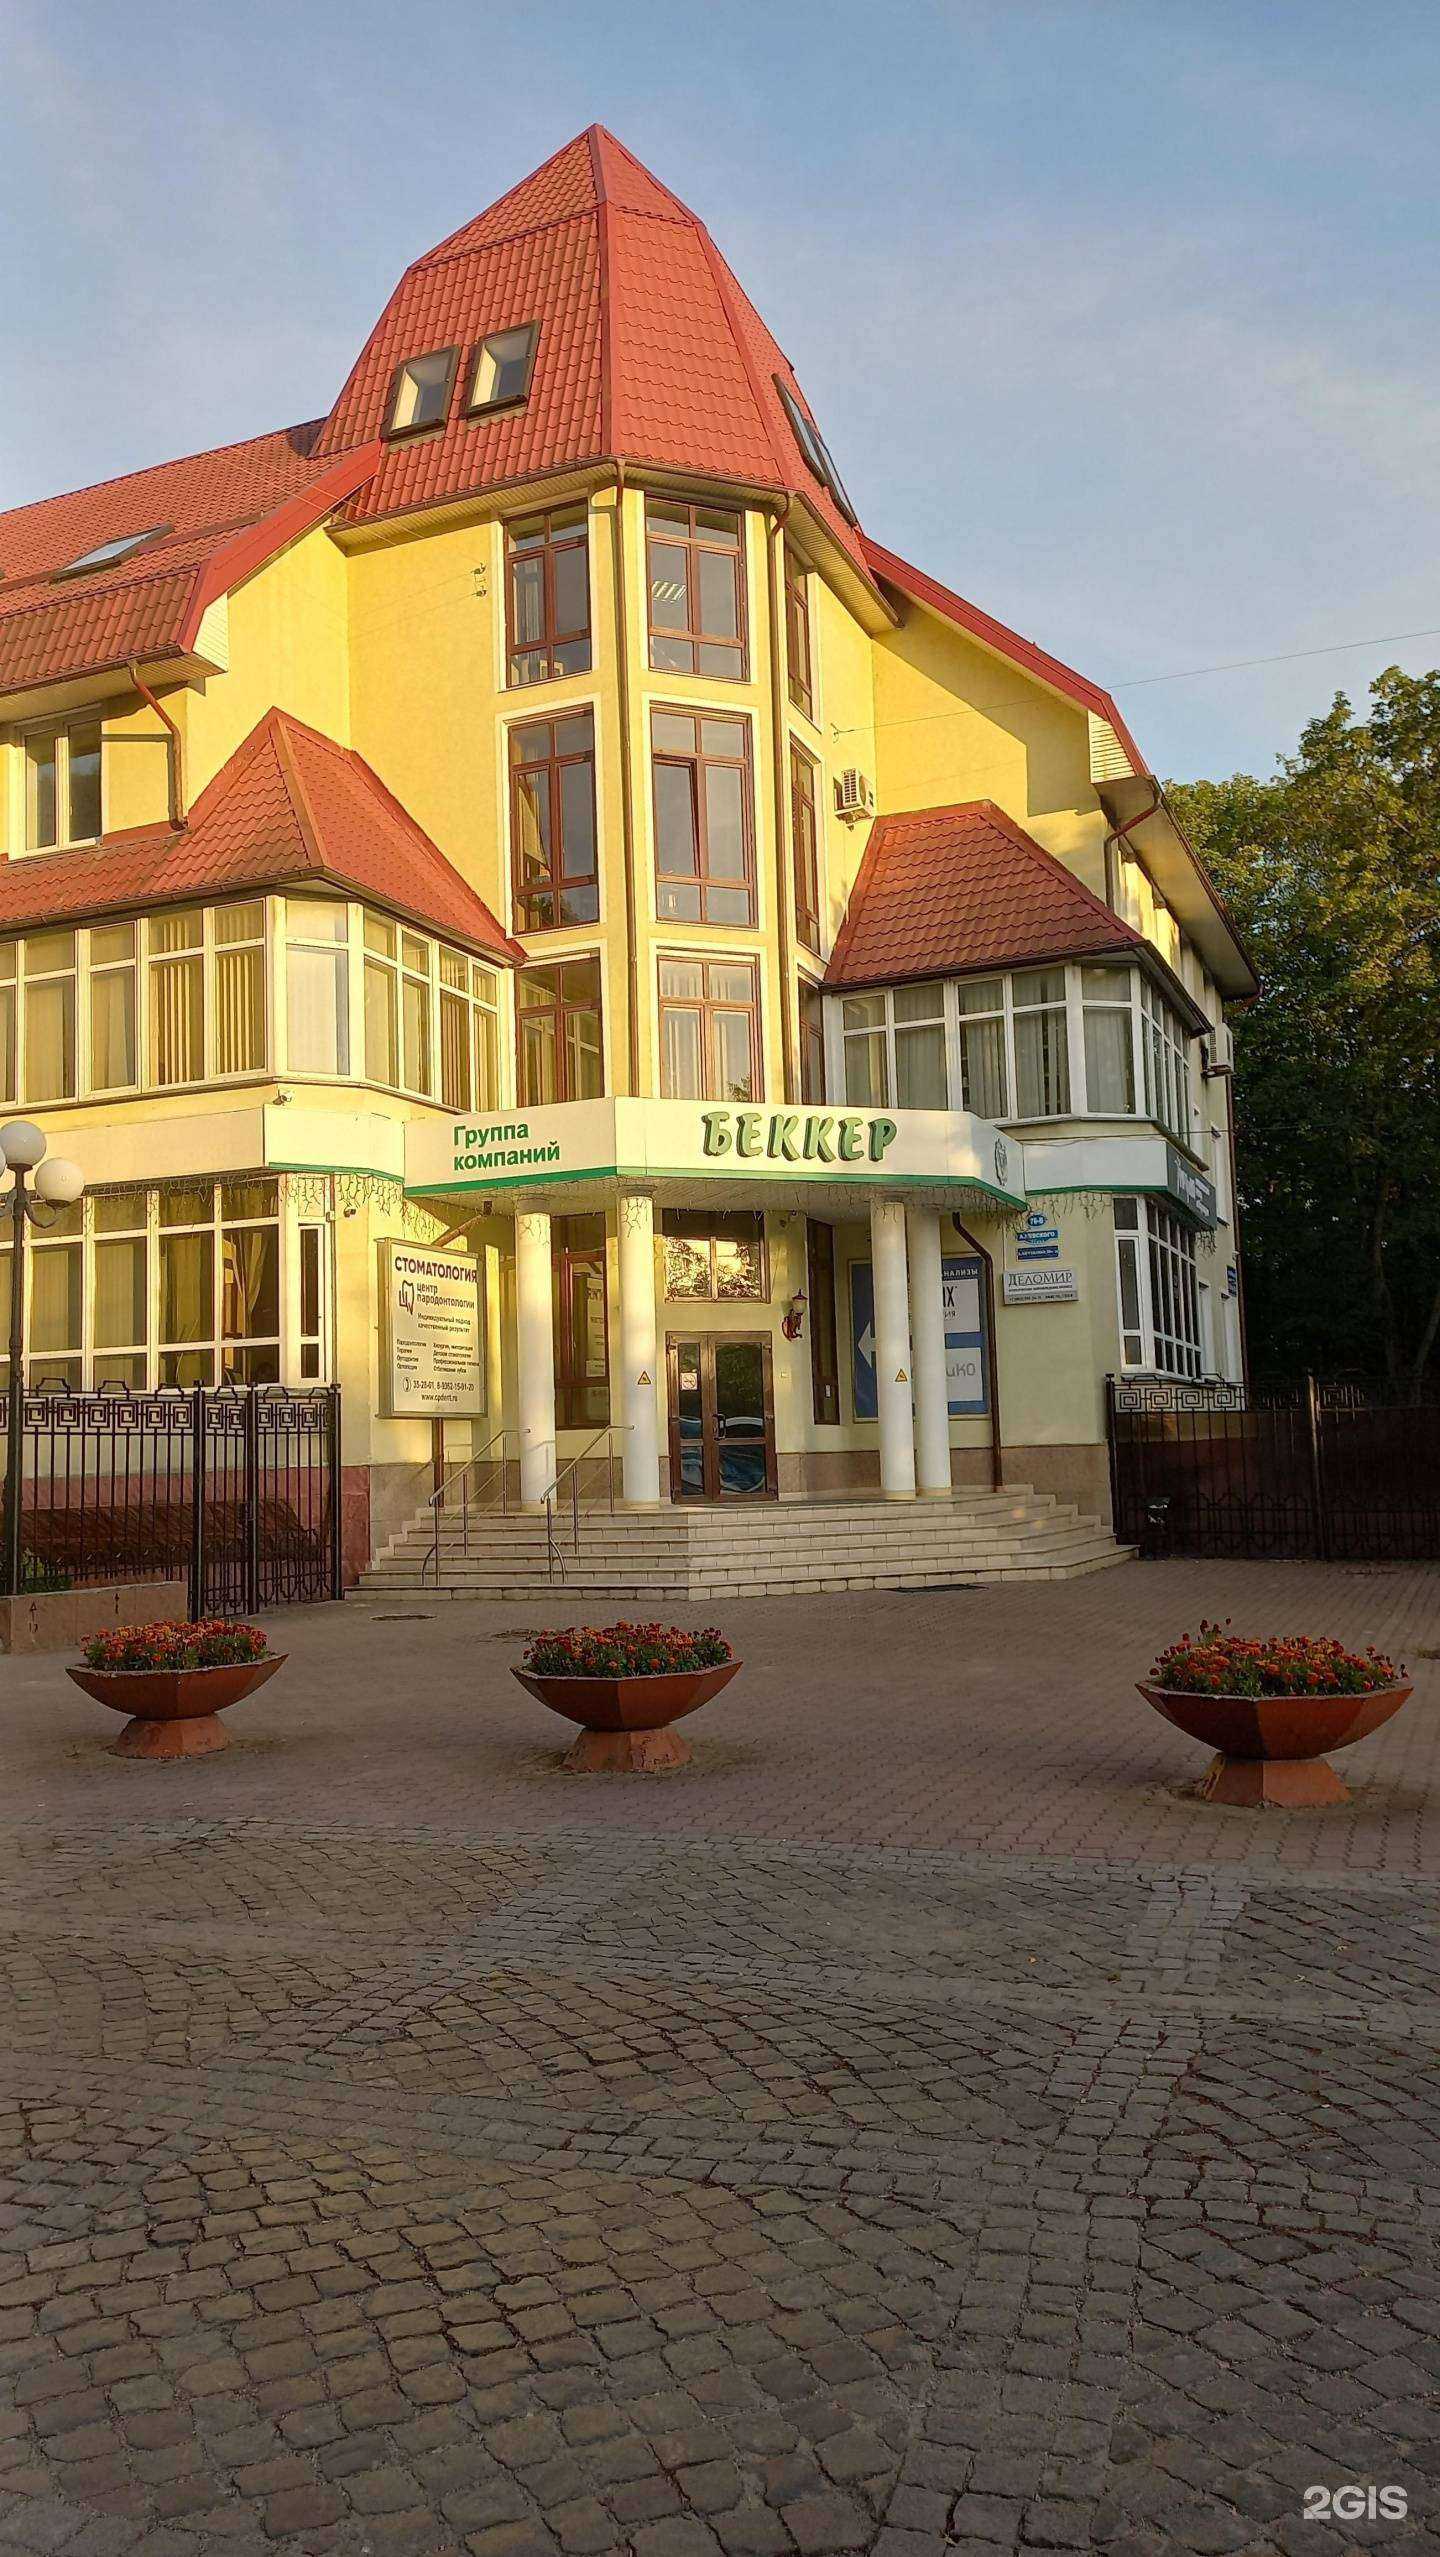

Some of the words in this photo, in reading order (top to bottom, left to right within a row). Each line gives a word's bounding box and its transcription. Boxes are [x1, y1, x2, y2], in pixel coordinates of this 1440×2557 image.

[453, 1123, 529, 1149] Группа
[701, 1111, 898, 1163] БЕККЕР
[453, 1140, 560, 1171] компаний
[395, 1255, 478, 1283] СТОМАТОЛОГИЯ
[943, 1268, 978, 1278] НАЛИЗЫ
